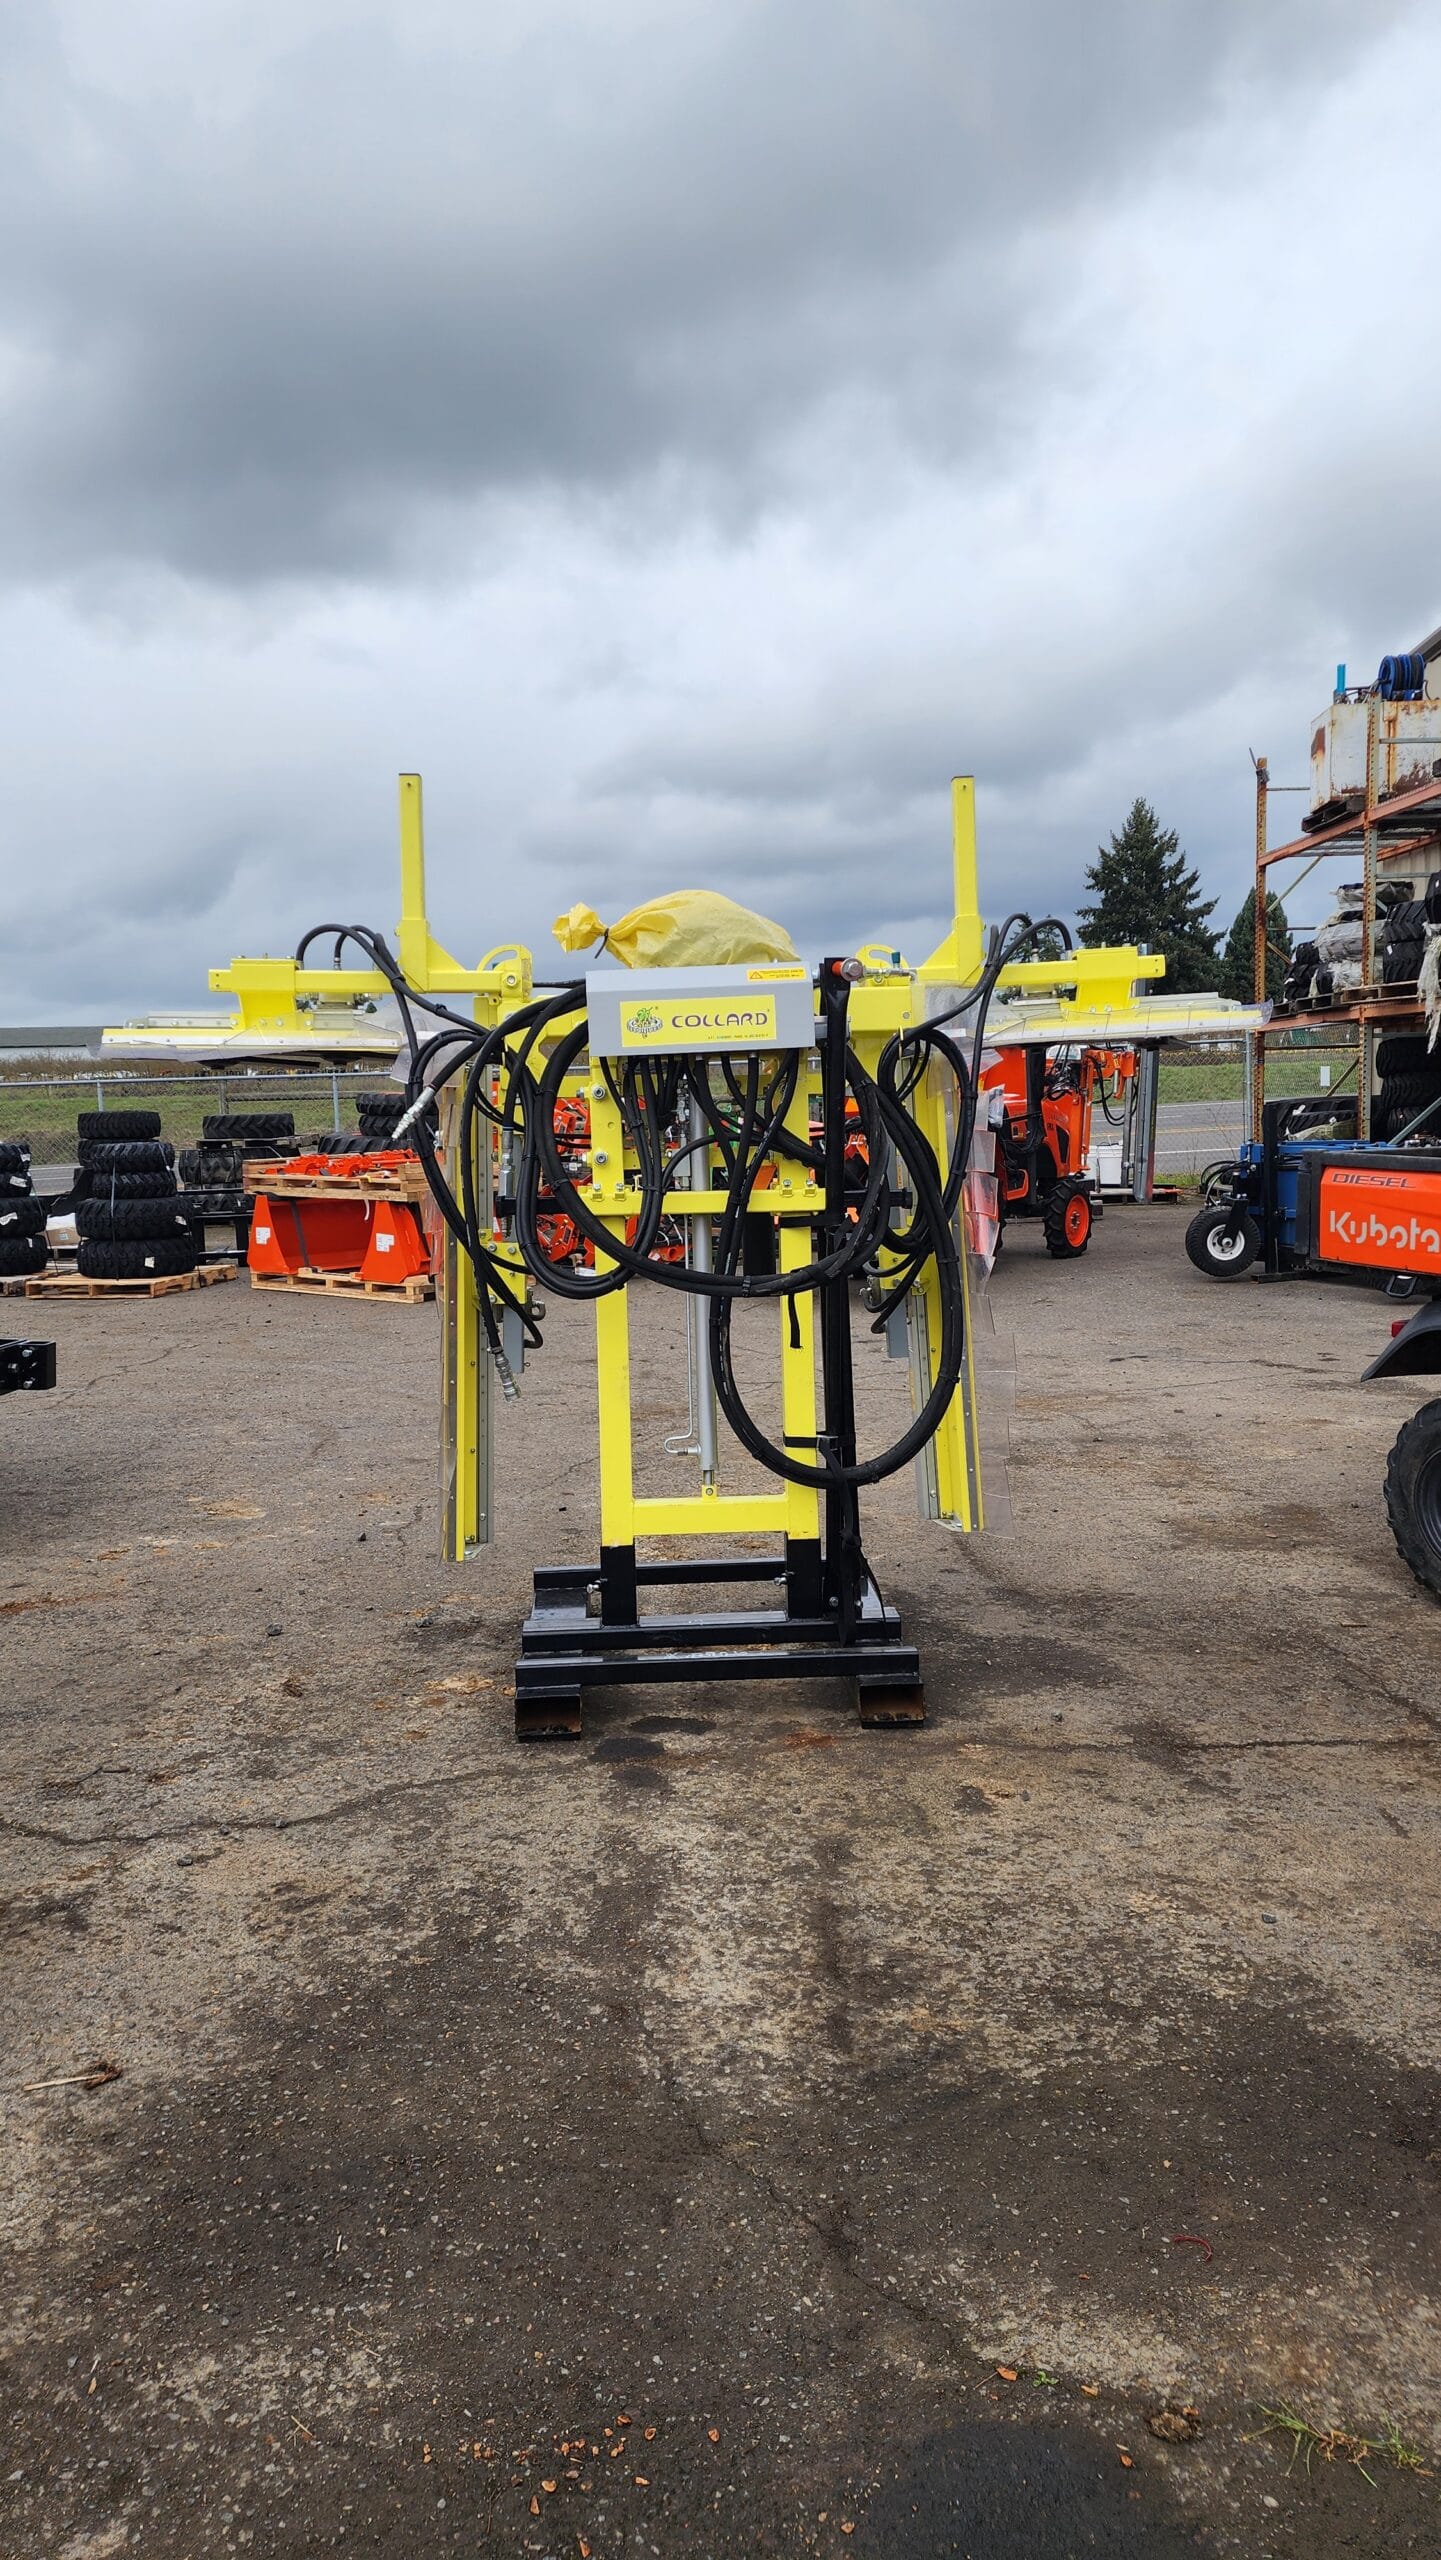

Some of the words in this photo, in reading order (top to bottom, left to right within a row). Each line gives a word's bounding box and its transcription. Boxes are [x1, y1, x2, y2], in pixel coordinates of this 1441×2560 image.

[672, 1012, 768, 1028] COLLARD
[1333, 1173, 1414, 1188] DIESEL
[1330, 1210, 1440, 1253] Kubota
